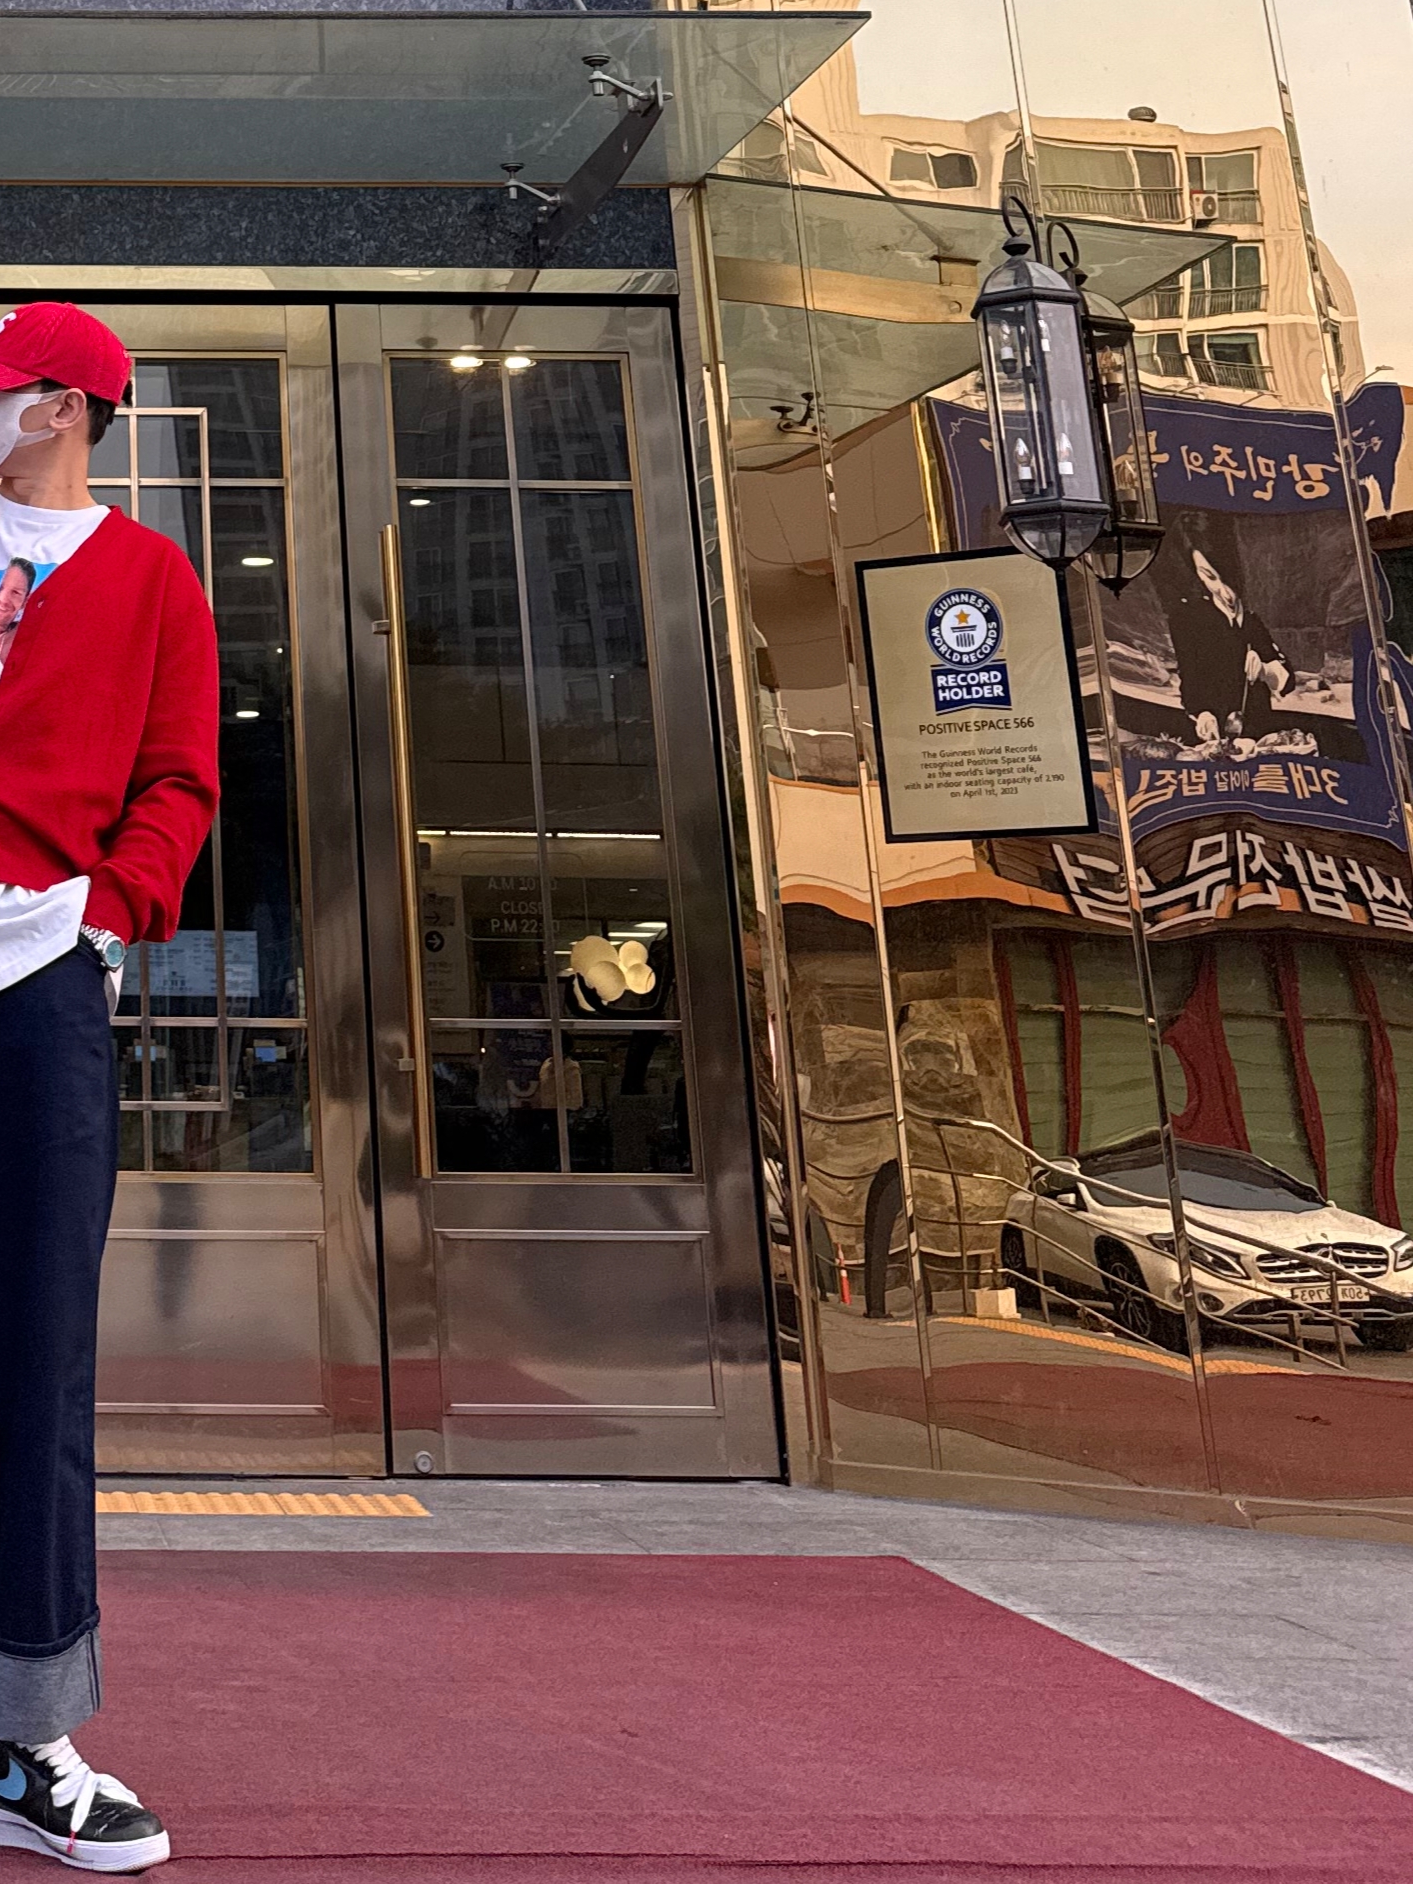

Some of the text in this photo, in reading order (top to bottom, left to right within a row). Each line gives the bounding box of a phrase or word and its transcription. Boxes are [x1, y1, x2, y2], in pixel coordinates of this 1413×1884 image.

[933, 593, 990, 617] GUINNESS
[930, 621, 997, 664] WORLD RECORDS
[936, 670, 1002, 687] RECORD
[938, 684, 1005, 701] HOLDER
[919, 716, 1035, 735] POSITIVE SPACE 566
[921, 743, 1039, 759] The Guinness World Records
[920, 758, 965, 770] recognized
[966, 755, 999, 767] Positive
[1000, 755, 1027, 766] Space
[926, 771, 937, 780] as
[938, 769, 952, 779] the
[985, 766, 1015, 777] largest
[903, 780, 922, 791] with
[923, 781, 935, 790] an
[936, 778, 963, 789] indoor
[964, 777, 995, 788] seating
[996, 775, 1032, 786] capacity
[1033, 773, 1044, 783] of
[950, 790, 962, 799] on
[962, 787, 983, 799] April
[999, 786, 1019, 796] 2023
[487, 876, 515, 891] A.M
[489, 917, 561, 934] P.M 22:0
